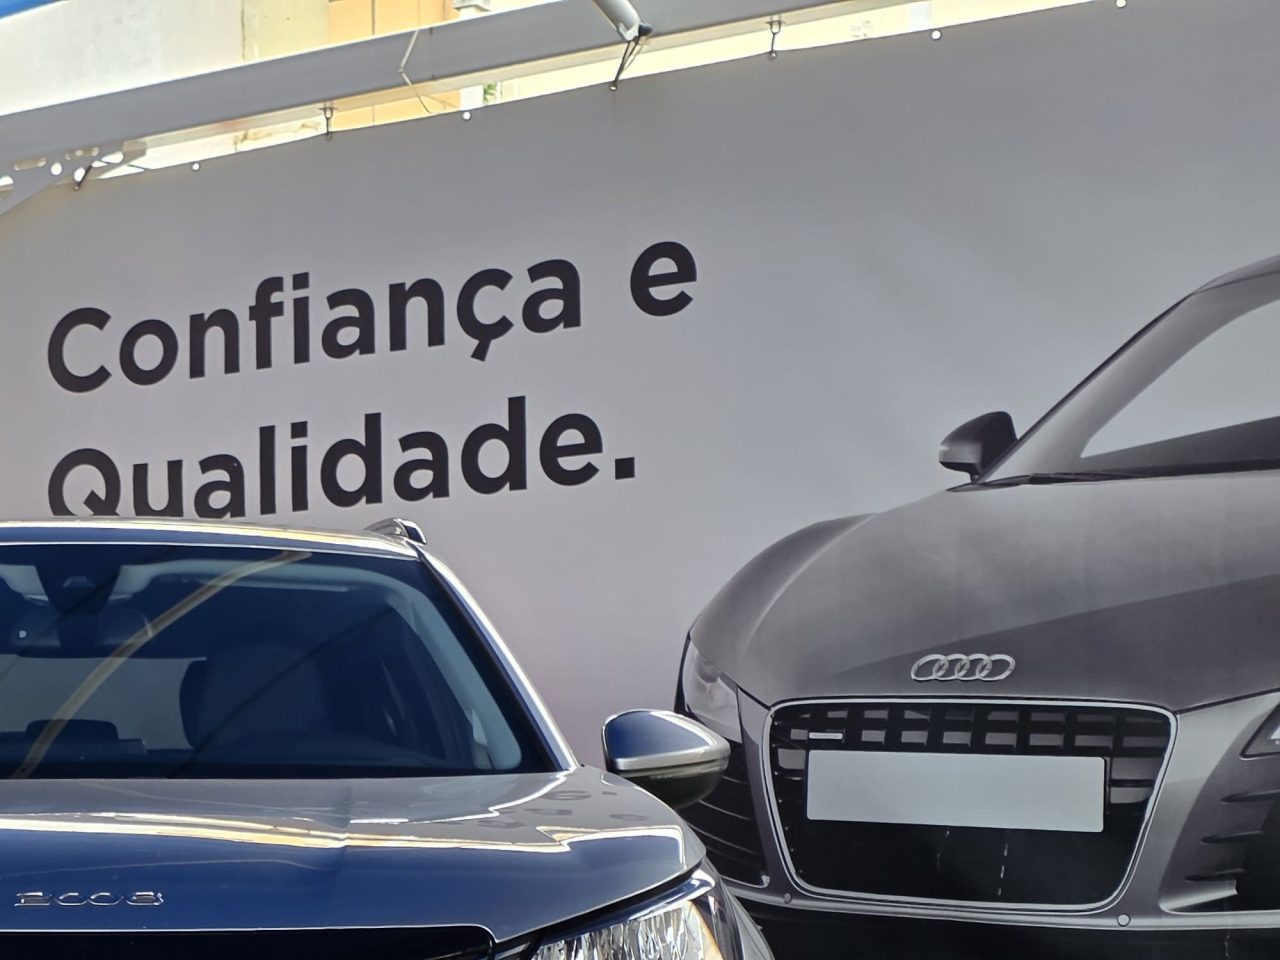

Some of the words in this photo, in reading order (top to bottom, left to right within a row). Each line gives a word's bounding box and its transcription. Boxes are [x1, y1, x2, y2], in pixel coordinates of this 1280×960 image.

[47, 259, 581, 393] Confiança
[630, 241, 697, 317] e
[47, 396, 635, 518] Qualidade.
